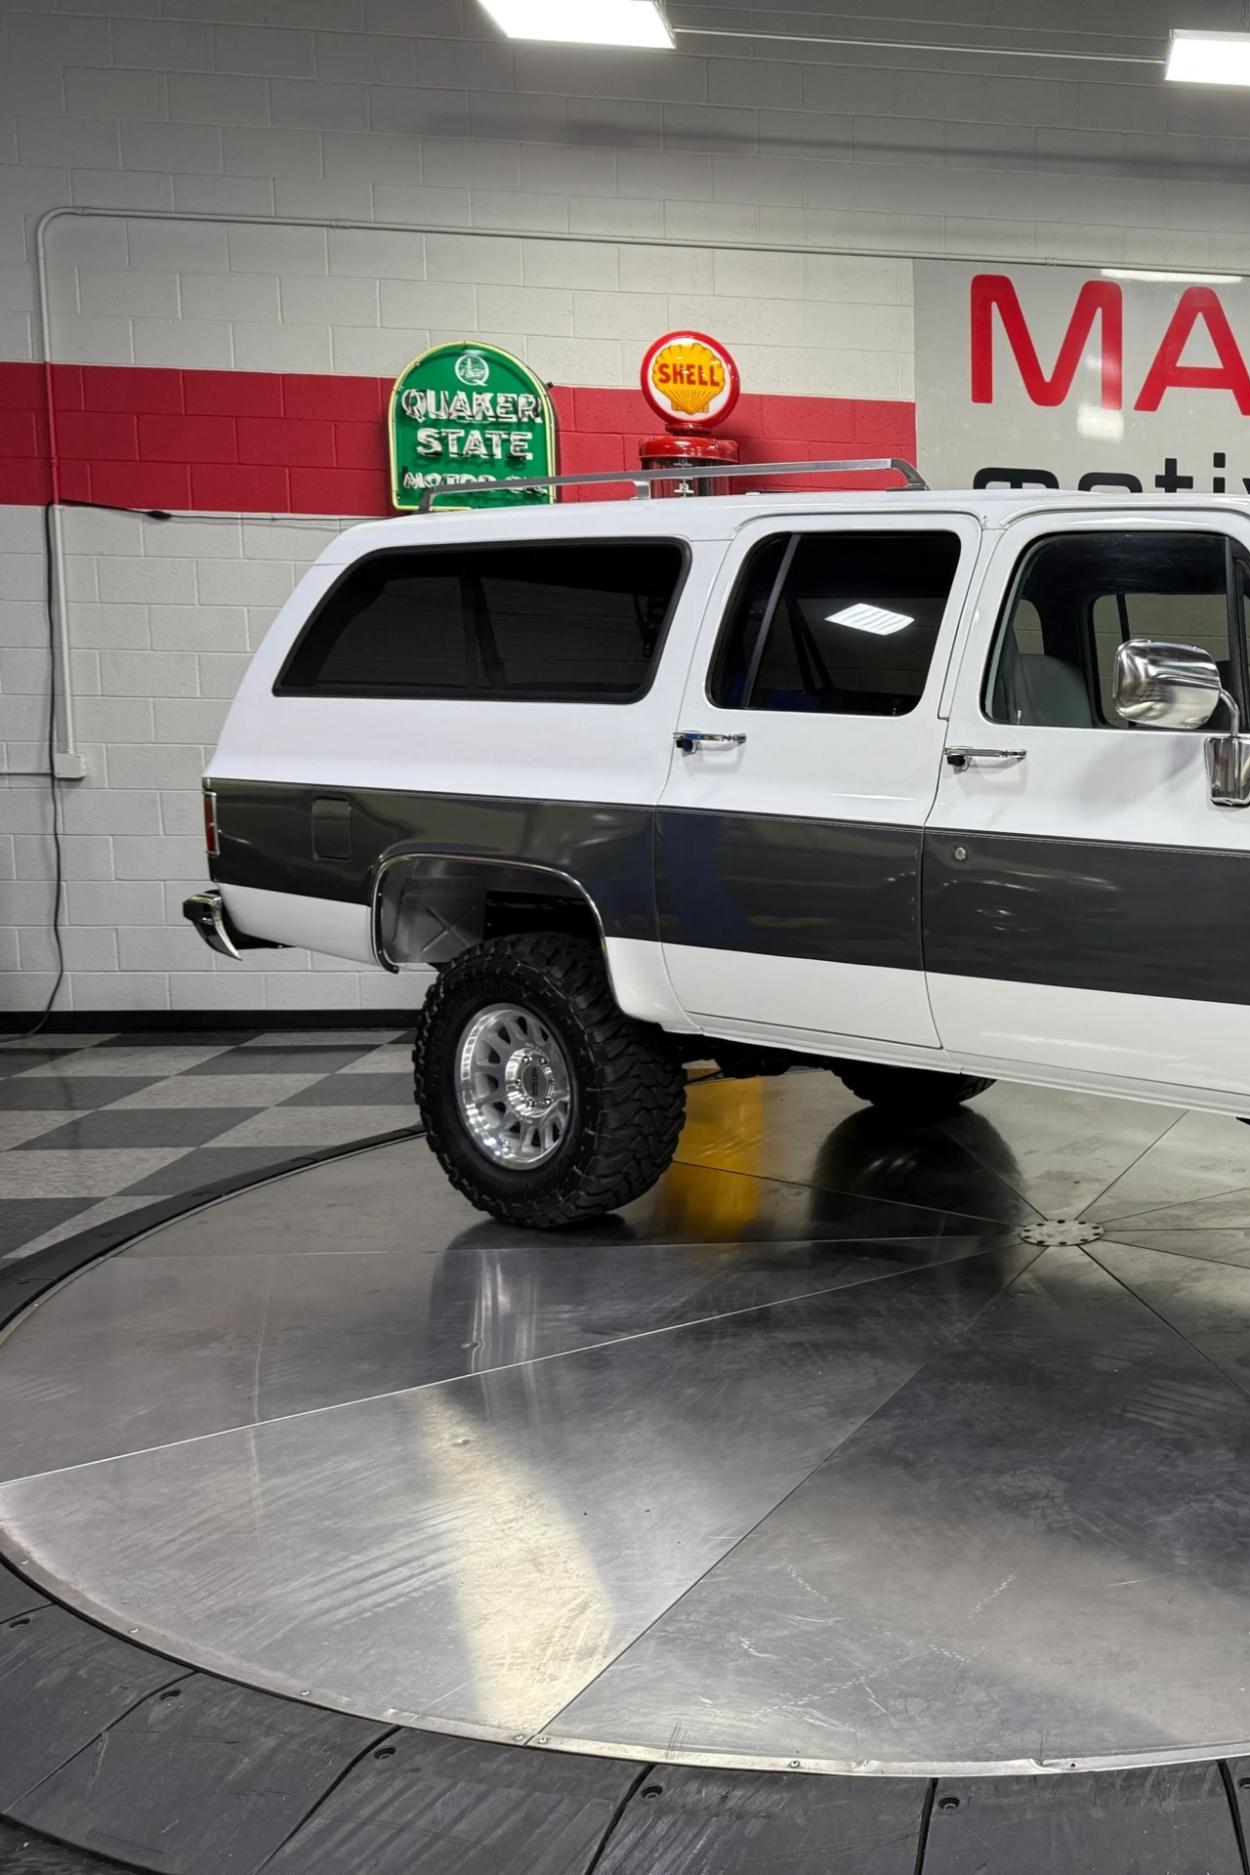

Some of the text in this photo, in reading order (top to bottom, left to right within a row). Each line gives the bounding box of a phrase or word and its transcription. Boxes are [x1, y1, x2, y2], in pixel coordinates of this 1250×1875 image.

[658, 363, 720, 387] SHELL
[401, 389, 544, 424] QUAKER
[416, 428, 534, 461] STATE
